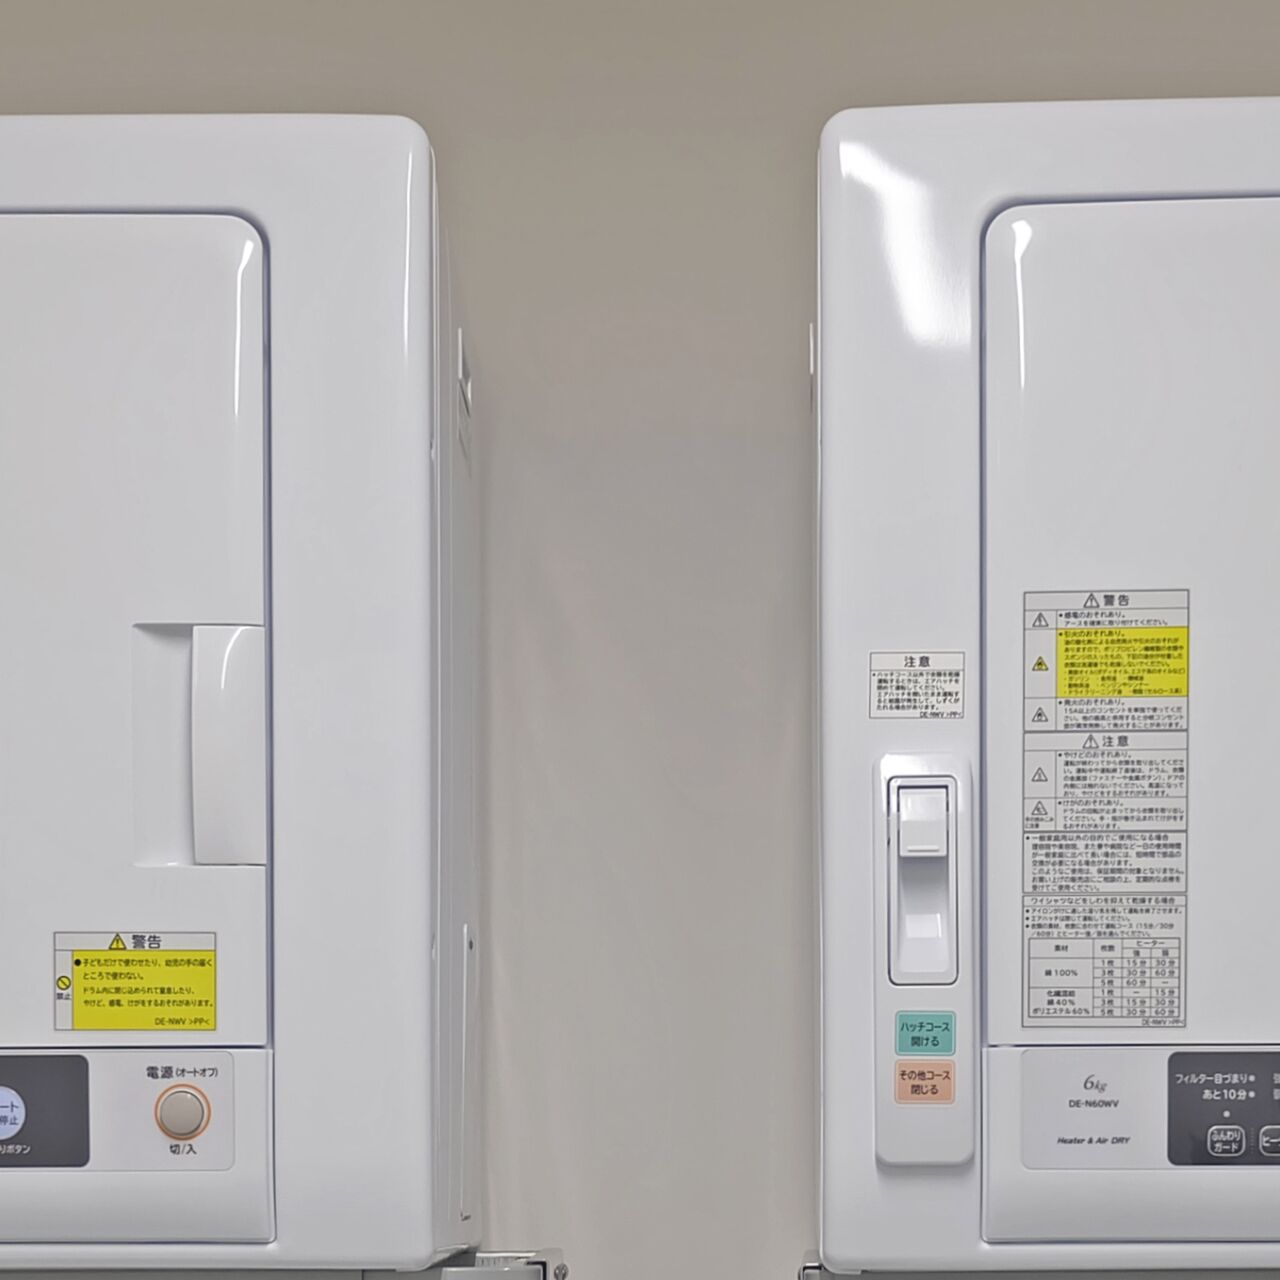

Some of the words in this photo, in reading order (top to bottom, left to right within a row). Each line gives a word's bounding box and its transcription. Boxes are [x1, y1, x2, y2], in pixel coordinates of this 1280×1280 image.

[1103, 595, 1130, 607] 警告
[904, 656, 930, 667] 注意
[1102, 736, 1129, 747] 注意
[132, 935, 161, 948] 警告
[901, 1022, 950, 1032] ハッチコース
[911, 1036, 939, 1047] 開ける
[146, 1066, 174, 1079] 電源
[900, 1071, 951, 1080] その他コース
[1176, 1074, 1247, 1084] フィルター目づまり
[911, 1085, 938, 1094] 閉じる
[1203, 1089, 1247, 1100] あと10分
[1057, 1137, 1084, 1145] Heater
[1112, 1136, 1130, 1144] DRY
[1212, 1131, 1241, 1141] ふんわり
[1214, 1143, 1239, 1152] ガード
